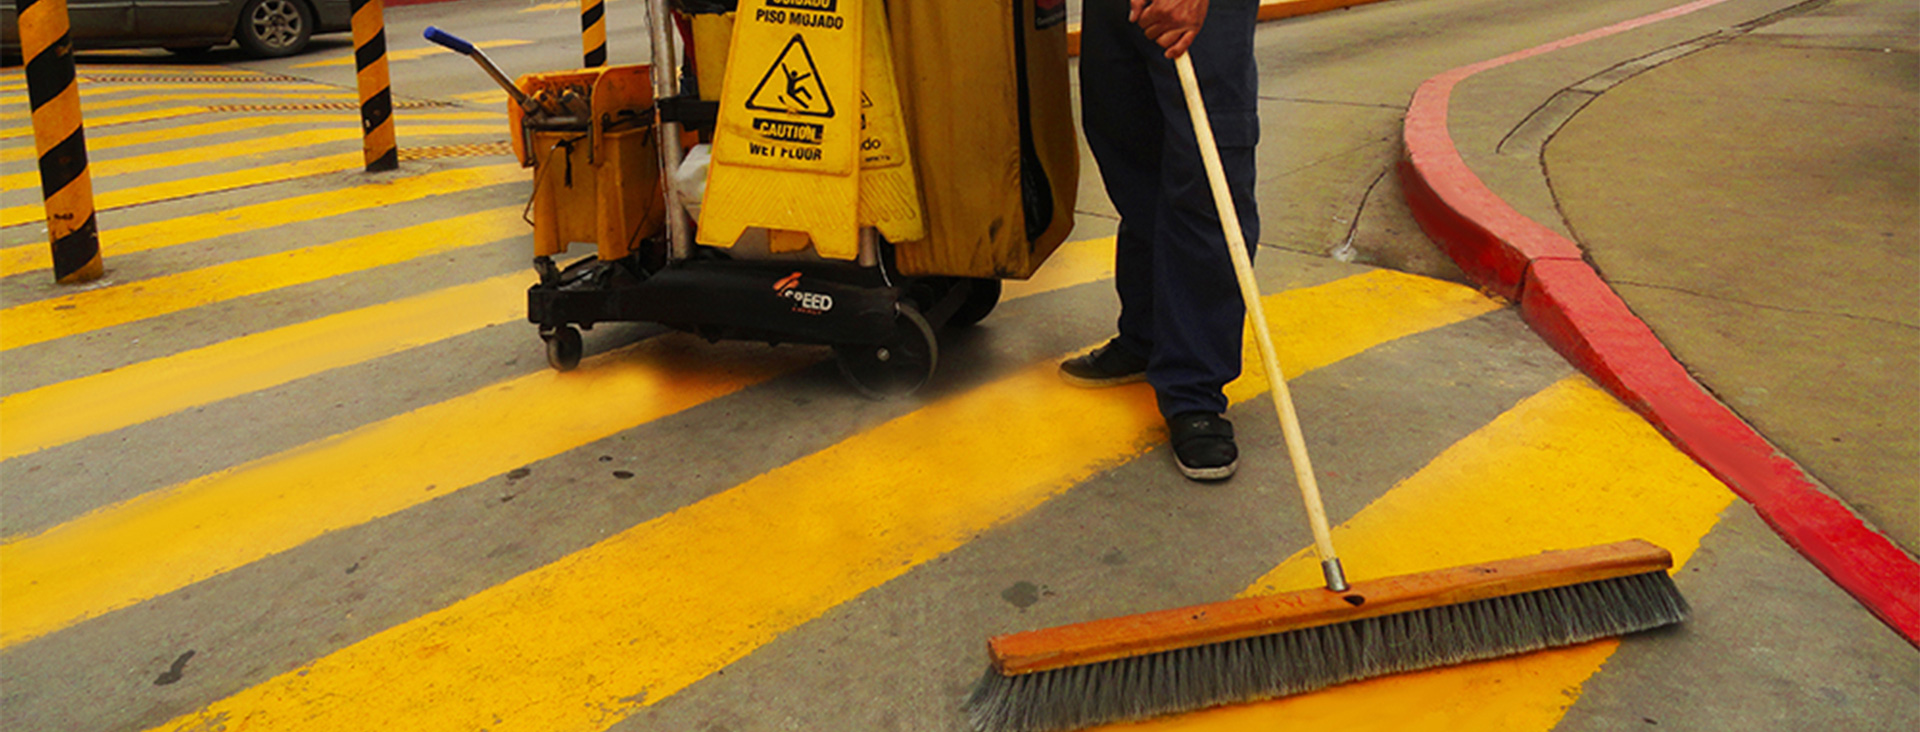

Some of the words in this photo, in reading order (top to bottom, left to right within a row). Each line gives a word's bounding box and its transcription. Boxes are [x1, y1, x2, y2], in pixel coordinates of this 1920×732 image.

[756, 8, 786, 24] PISO
[789, 11, 844, 30] MOJADO
[760, 121, 817, 142] CAUTION
[780, 147, 822, 161] FLOOR
